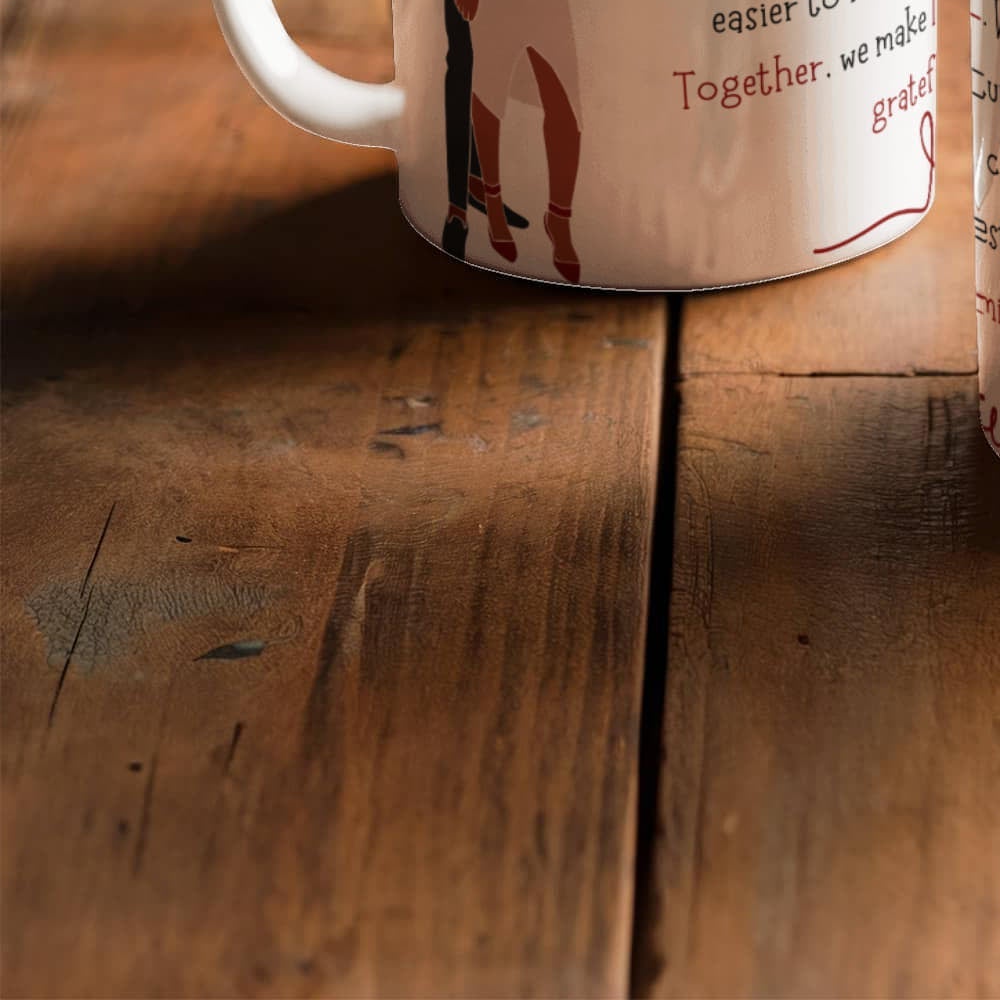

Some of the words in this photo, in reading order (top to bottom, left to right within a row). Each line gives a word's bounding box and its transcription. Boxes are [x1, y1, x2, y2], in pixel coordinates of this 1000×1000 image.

[712, 0, 798, 33] easier
[840, 42, 868, 71] we
[875, 5, 927, 58] make
